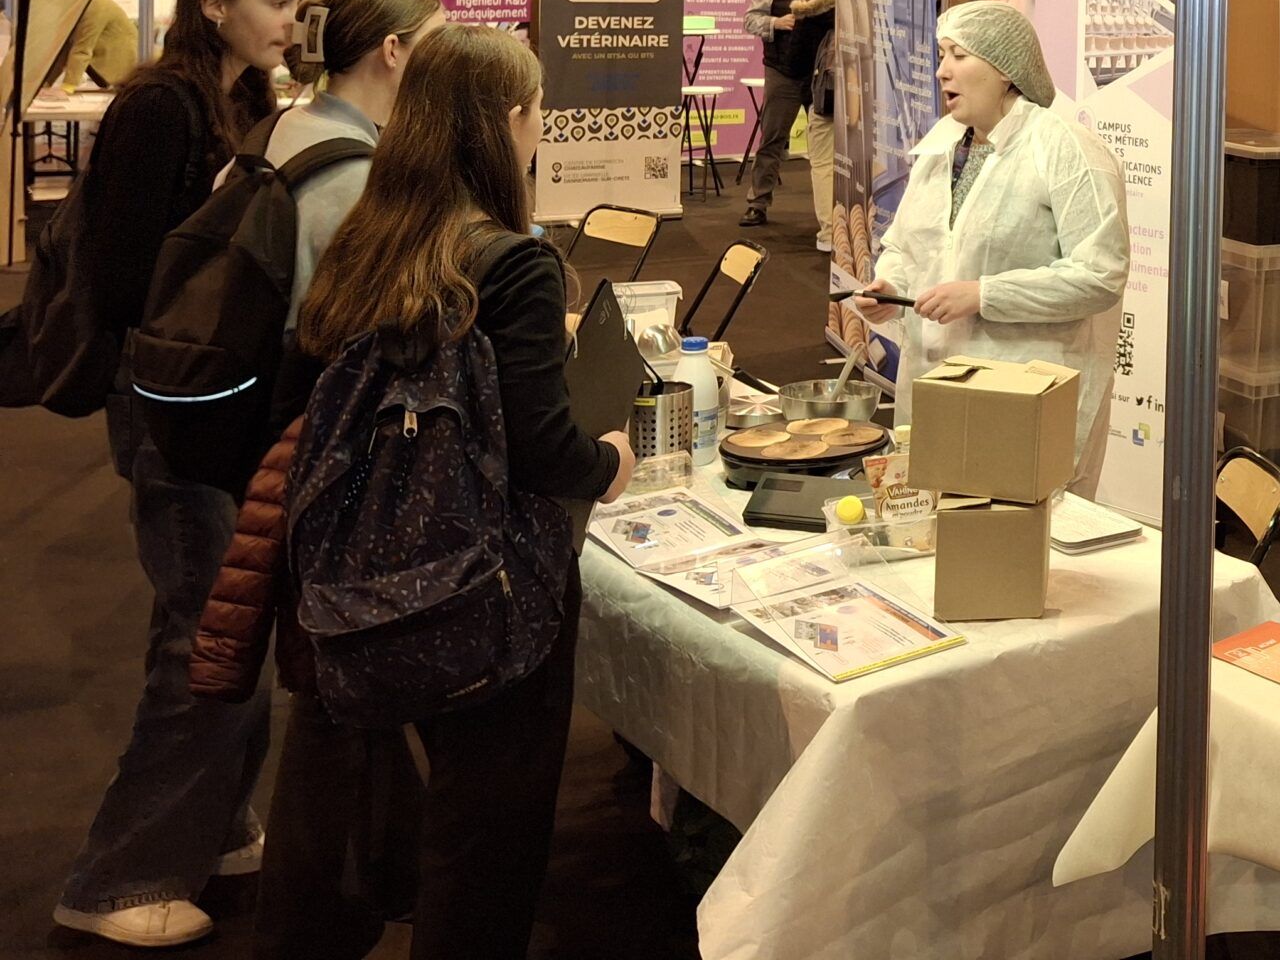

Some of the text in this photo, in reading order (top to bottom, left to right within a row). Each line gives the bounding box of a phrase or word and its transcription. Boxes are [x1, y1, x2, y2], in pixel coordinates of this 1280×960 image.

[575, 16, 654, 29] DEVENEZ
[557, 32, 669, 48] VÉTÉRINAIRE
[1097, 121, 1131, 133] CAMPUS
[1115, 134, 1149, 148] MÉTIERS
[1118, 395, 1130, 403] sur
[886, 498, 929, 511] Amandes
